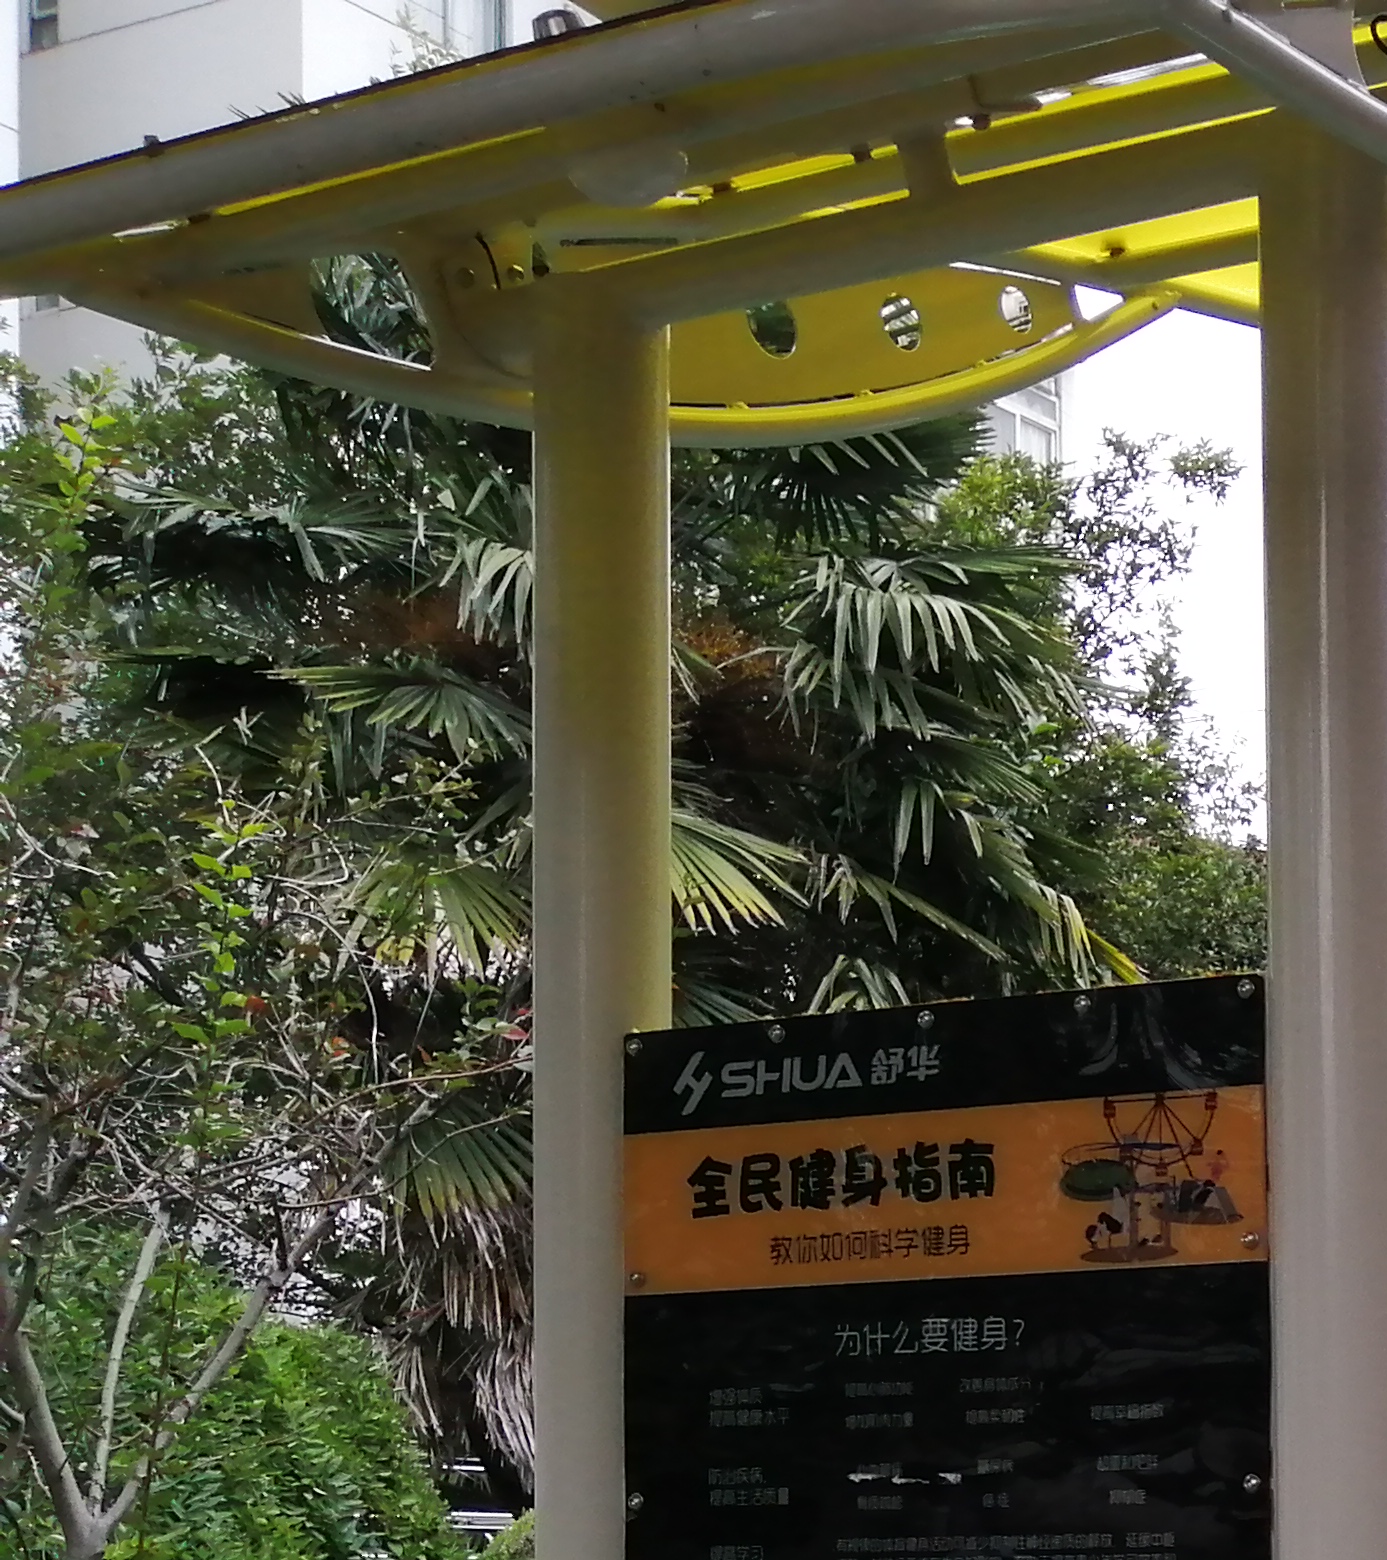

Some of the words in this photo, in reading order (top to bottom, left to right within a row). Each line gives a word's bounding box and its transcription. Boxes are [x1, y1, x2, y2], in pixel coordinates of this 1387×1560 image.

[721, 1053, 863, 1098] SHUA
[870, 1045, 941, 1085] 舒华
[687, 1138, 995, 1220] 全民健身指南
[770, 1224, 971, 1266] 教你如何科学健身
